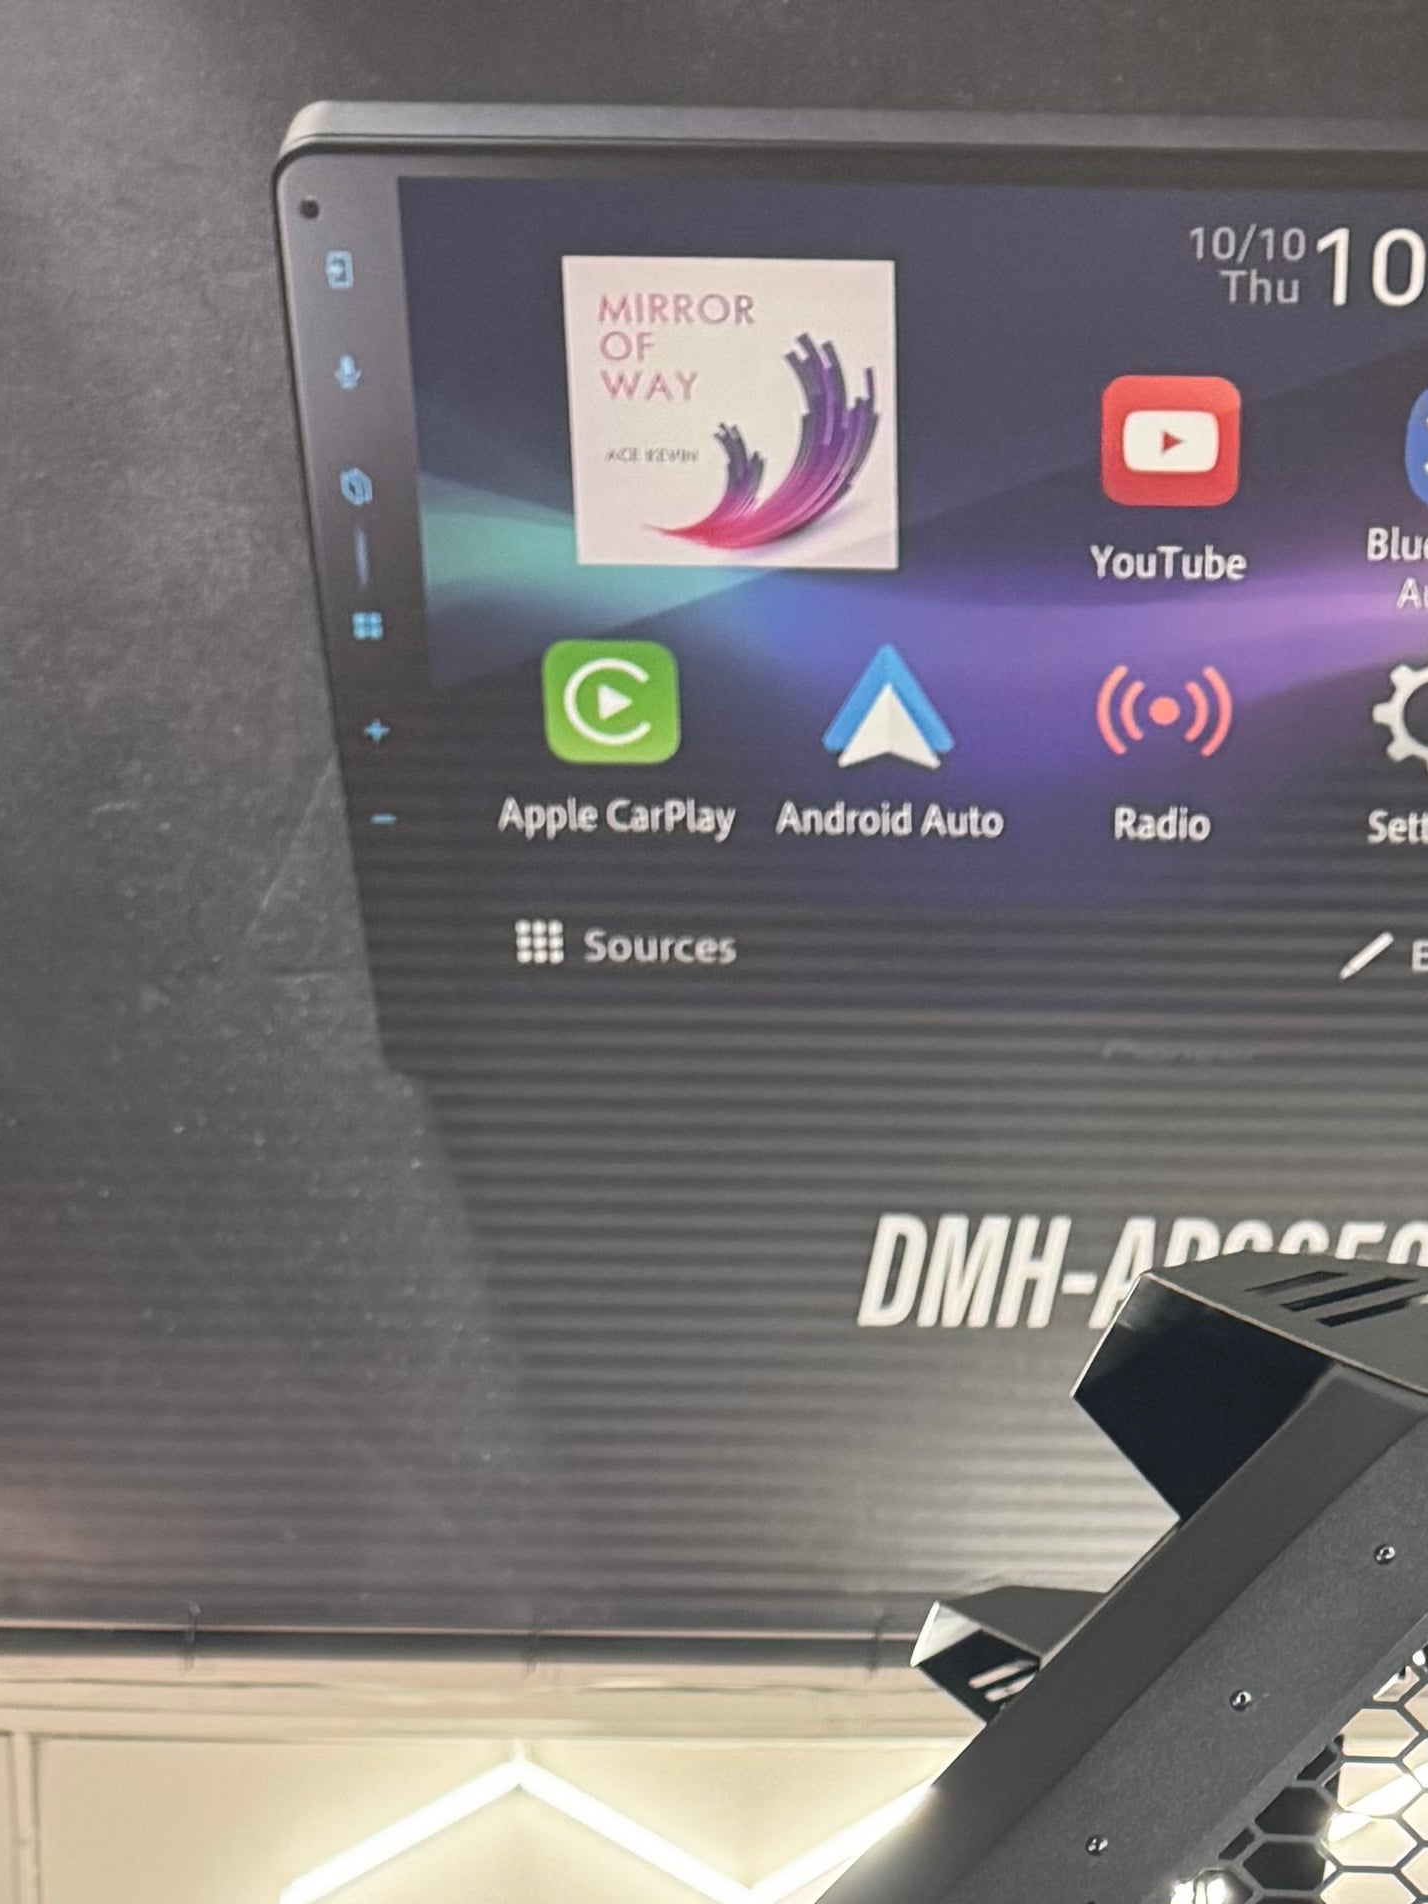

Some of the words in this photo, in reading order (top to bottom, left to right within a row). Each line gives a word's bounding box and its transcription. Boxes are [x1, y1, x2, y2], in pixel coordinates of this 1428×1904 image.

[1188, 224, 1309, 266] 10/10
[1220, 271, 1300, 306] Thu
[598, 293, 756, 326] MIRROR
[599, 331, 655, 362] OF
[600, 369, 699, 401] WAY
[1089, 545, 1248, 582] YouTube
[498, 799, 598, 839] Apple
[606, 798, 737, 843] CarPlay
[776, 800, 914, 837] Android
[922, 804, 1005, 838] Auto
[1113, 807, 1212, 844] Radio
[582, 930, 738, 966] Sources
